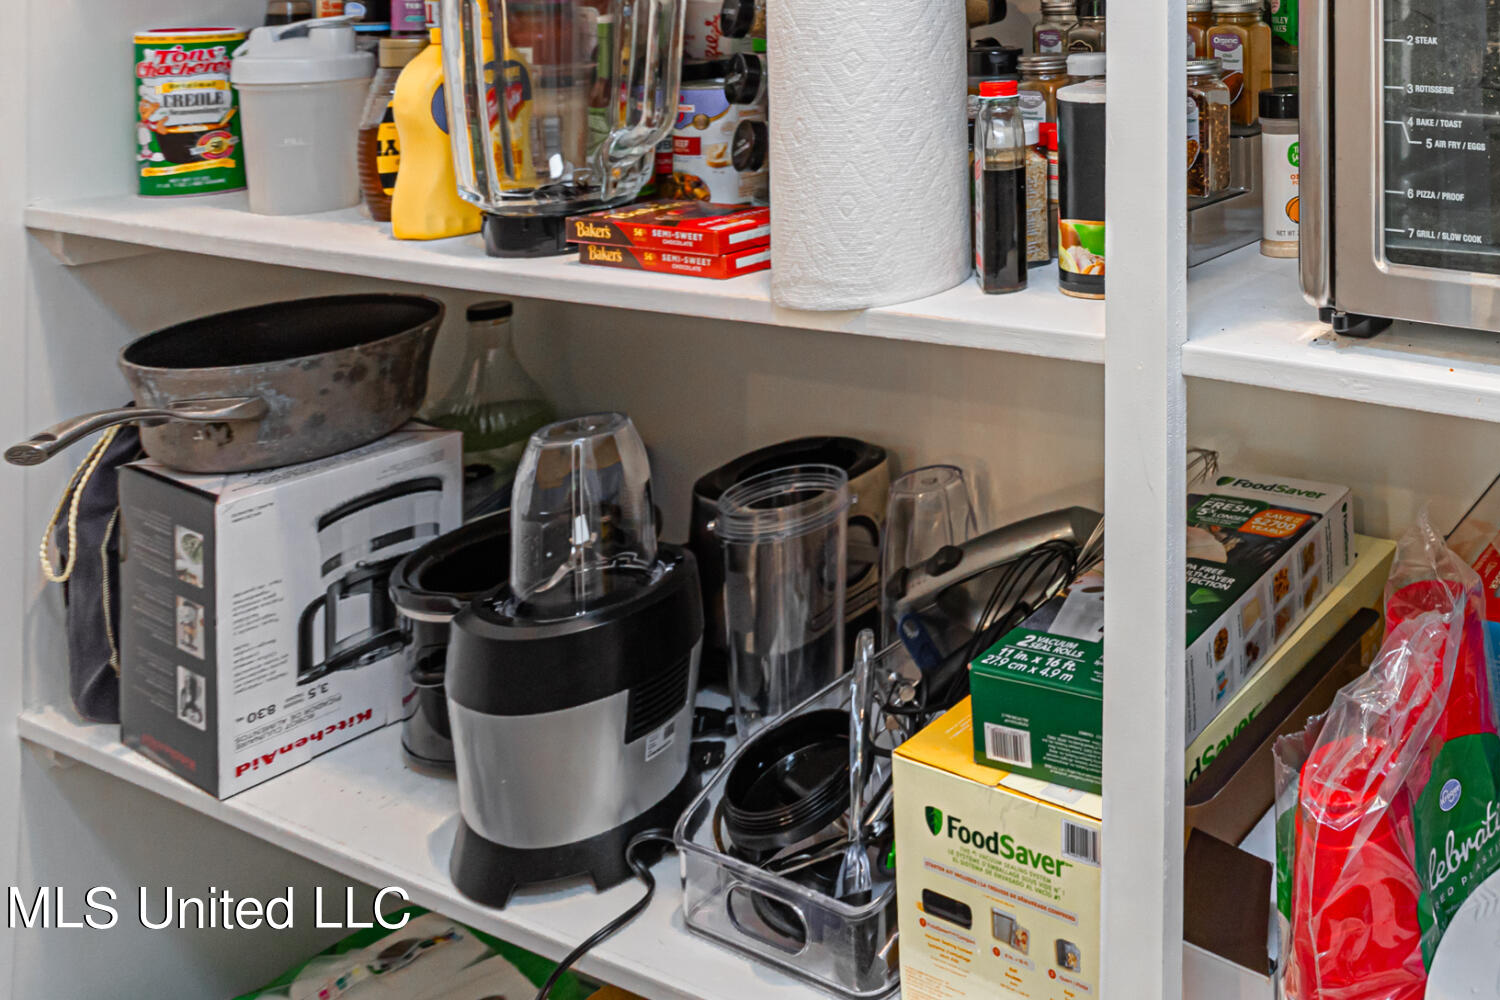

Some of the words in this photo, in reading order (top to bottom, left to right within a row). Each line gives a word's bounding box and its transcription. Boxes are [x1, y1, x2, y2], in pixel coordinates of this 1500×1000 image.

[1213, 36, 1239, 46] Organic
[1407, 35, 1414, 46] 2
[1414, 36, 1438, 45] STEAK
[1407, 83, 1413, 94] 3
[1414, 84, 1455, 95] ROTISSERIE
[162, 92, 224, 108] CREOLE
[1407, 117, 1414, 127] 4
[1416, 118, 1435, 127] BAKE
[1440, 119, 1463, 128] TOAST
[1426, 138, 1433, 149] 5
[1434, 140, 1447, 149] AIR
[1447, 140, 1462, 150] FRY
[1467, 142, 1486, 151] EGGS
[1407, 188, 1414, 199] 6
[1416, 190, 1436, 199] PIZZA
[1441, 192, 1465, 201] PROOF
[651, 229, 704, 242] SEMI-SWEET
[1408, 228, 1415, 238] 7
[1416, 229, 1436, 239] GRILL
[1442, 232, 1462, 241] SLOW
[1462, 234, 1483, 244] COOK
[662, 239, 694, 247] CHOCOLATE
[661, 253, 712, 266] SEMI-SWEET
[671, 263, 702, 272] CHOCOLATE
[1233, 479, 1327, 500] FoodSaver
[1200, 499, 1258, 514] FRESH
[1251, 517, 1297, 531] $2700
[1264, 512, 1293, 522] SAVE
[1200, 565, 1226, 576] FREE
[1016, 634, 1037, 648] 2
[1037, 636, 1079, 650] VACUUM
[1029, 642, 1053, 653] SEAL
[1053, 647, 1085, 658] ROLLS
[998, 647, 1015, 657] 11
[1014, 650, 1029, 662] in.
[1031, 656, 1042, 664] x
[1045, 657, 1061, 668] 16
[1062, 660, 1077, 672] ft.
[981, 654, 1010, 667] 27.9
[1007, 661, 1028, 672] cm
[1028, 666, 1039, 674] x
[1039, 666, 1061, 678] 4.9
[1059, 672, 1075, 682] m
[307, 682, 329, 700] 3.5
[246, 703, 277, 723] 830
[235, 708, 373, 778] KitchenAid
[947, 815, 1067, 878] FoodSaver
